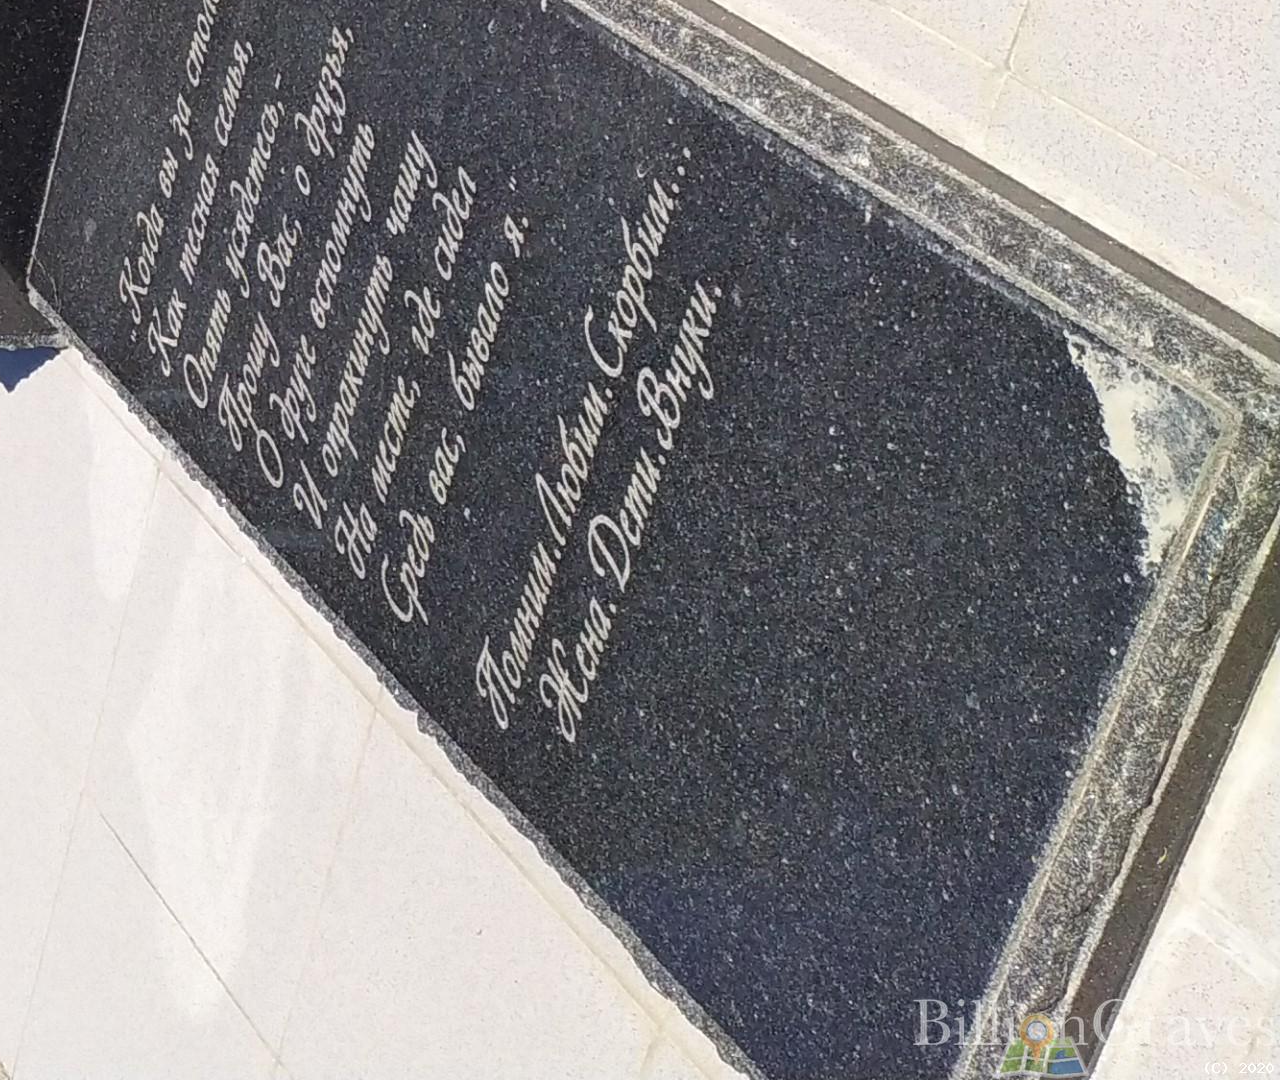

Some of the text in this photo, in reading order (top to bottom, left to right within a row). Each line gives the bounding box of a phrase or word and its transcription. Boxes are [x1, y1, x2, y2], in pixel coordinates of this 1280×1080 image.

[147, 40, 253, 376] Как тесная семья,
[158, 147, 180, 198] вы
[169, 92, 193, 160] за
[218, 26, 354, 450] Прошу Вас, о друзья,
[184, 289, 232, 408] Опять
[255, 430, 284, 488] О
[269, 335, 317, 444] друге
[293, 129, 438, 529] И опракинуть чашу
[334, 165, 477, 579] На месте, где сидел
[380, 510, 436, 623] Средь
[429, 427, 466, 505] вас,
[448, 261, 508, 411] бывало
[539, 286, 722, 742] Жена. Дети. Внуки.
